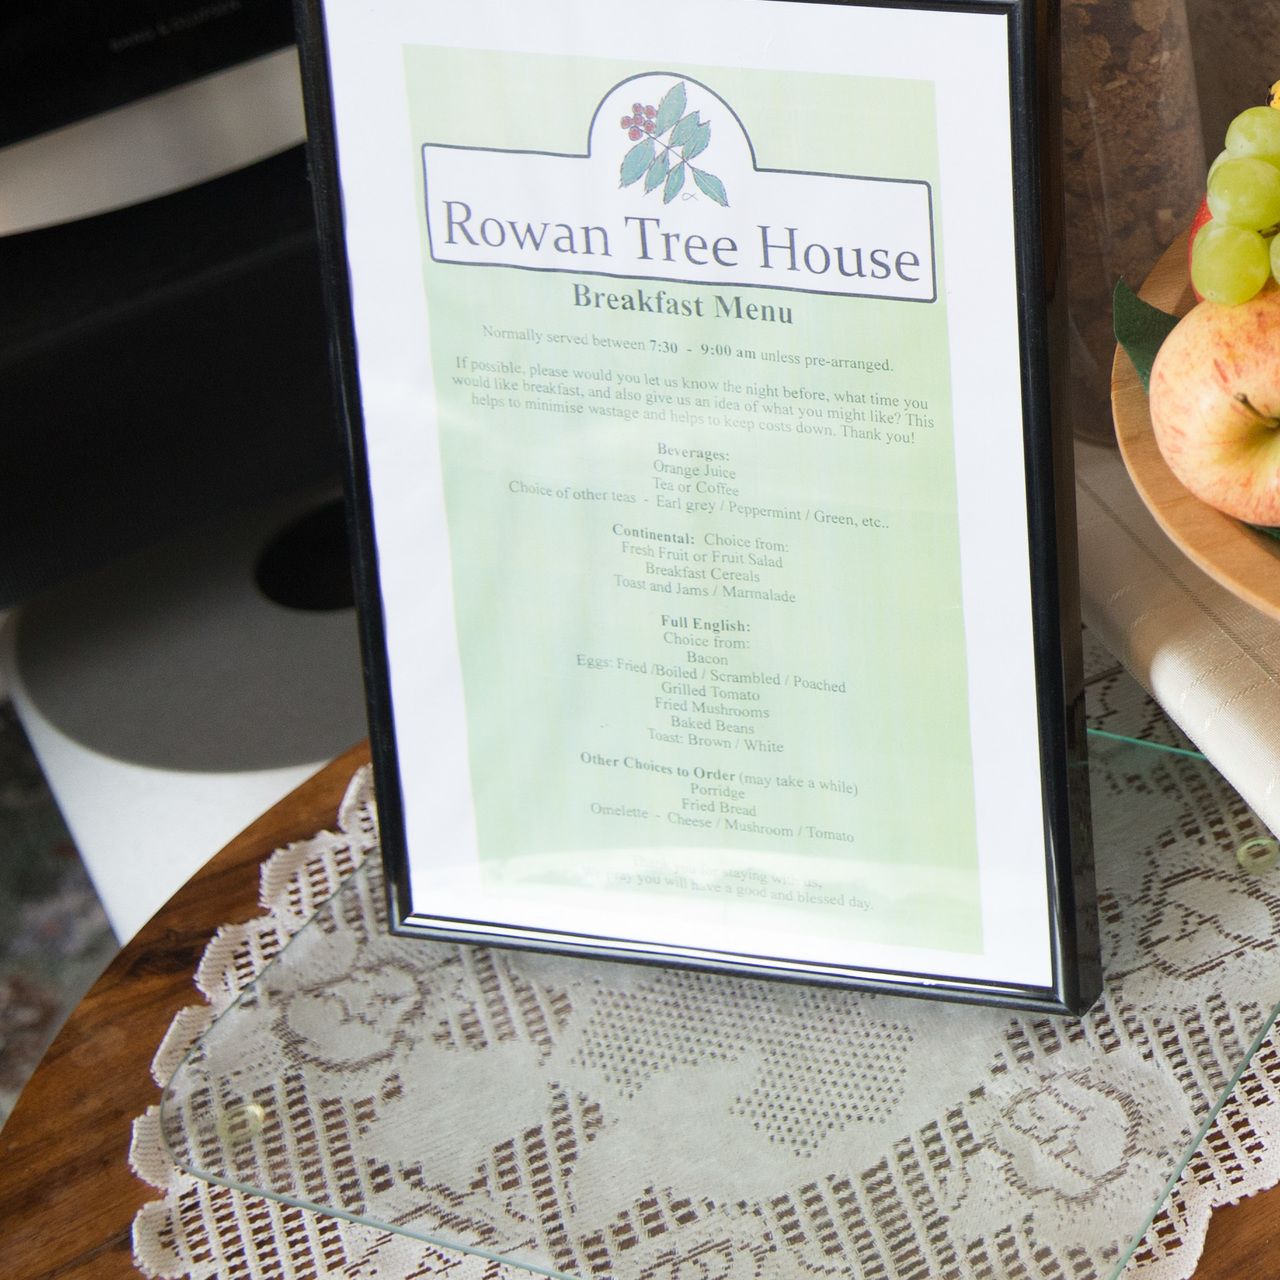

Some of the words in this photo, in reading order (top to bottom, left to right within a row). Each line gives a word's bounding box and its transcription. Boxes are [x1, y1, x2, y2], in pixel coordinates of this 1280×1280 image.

[442, 200, 612, 257] Rowan
[624, 216, 739, 267] Tree
[757, 225, 920, 282] House
[572, 282, 705, 317] Breakfast
[714, 295, 793, 324] Menu
[482, 324, 542, 344] Normally
[546, 330, 587, 344] served
[592, 334, 645, 350] between
[649, 339, 677, 352] 7:30
[700, 343, 731, 357] 9:00
[736, 349, 756, 359] am
[760, 348, 800, 363] unless
[804, 352, 893, 374] pre-arranged.
[456, 355, 469, 369] If
[529, 363, 568, 381] please
[572, 367, 612, 381] would
[616, 374, 640, 387] you
[644, 373, 660, 386] let
[664, 378, 677, 387] us
[681, 376, 718, 390] know
[723, 380, 741, 392] the
[746, 382, 778, 399] night
[782, 385, 829, 403] before,
[833, 389, 866, 403] what
[870, 393, 899, 406] time
[903, 398, 927, 412] you
[452, 373, 490, 388] would
[494, 377, 518, 390] like
[522, 380, 584, 399] breakfast,
[588, 386, 610, 399] and
[615, 388, 641, 401] also
[645, 394, 672, 407] give
[676, 396, 690, 406] us
[694, 398, 709, 407] an
[714, 397, 739, 410] idea
[744, 400, 758, 412] of
[762, 401, 793, 415] what
[798, 407, 822, 420] you
[827, 407, 865, 424] might
[870, 411, 901, 424] like?
[904, 414, 934, 428] This
[472, 393, 504, 410] helps
[508, 396, 520, 408] to
[525, 401, 583, 414] minimise
[588, 403, 639, 422] wastage
[643, 408, 665, 421] and
[670, 410, 703, 427] helps
[708, 414, 720, 426] to
[724, 415, 754, 432] keep
[758, 418, 791, 432] costs
[795, 422, 835, 436] down.
[840, 425, 881, 440] Thank
[885, 429, 914, 446] you!
[657, 443, 728, 463] Beverages:
[653, 461, 700, 479] Orange
[703, 465, 735, 478] Juice
[653, 476, 674, 490] Tea
[678, 483, 691, 492] or
[695, 481, 738, 495] Coffee
[508, 481, 552, 496] Choice
[556, 486, 570, 498] of
[572, 487, 607, 502] other
[611, 491, 635, 504] teas
[656, 495, 680, 508] Earl
[686, 501, 715, 515] grey
[728, 502, 800, 523] Peppermint
[813, 510, 858, 528] Green,
[612, 523, 694, 543] Continental:
[704, 533, 750, 549] Choice
[755, 538, 788, 552] from:
[622, 542, 654, 556] Fresh
[658, 545, 688, 559] Fruit
[692, 551, 707, 561] or
[711, 550, 744, 564] Fruit
[748, 554, 782, 568] Salad
[646, 562, 706, 578] Breakfast
[710, 568, 759, 582] Cereals
[614, 576, 646, 590] Toast
[649, 579, 671, 592] and
[676, 581, 708, 595] Jams
[722, 585, 795, 602] Marmalade
[661, 615, 687, 628] Full
[692, 617, 750, 634] English:
[663, 632, 708, 646] Choice
[713, 636, 749, 649] from:
[687, 652, 727, 666] Bacon
[617, 659, 646, 673] Fried
[710, 668, 780, 686] Scrambled
[793, 677, 846, 693] Poached
[661, 682, 706, 696] Grilled
[710, 686, 759, 700] Tomato
[655, 697, 687, 711] Fried
[692, 701, 769, 718] Mushrooms
[671, 716, 711, 731] Baked
[716, 720, 754, 734] Beans
[649, 728, 683, 743] Toast:
[688, 732, 731, 747] Brown
[744, 738, 783, 752] White
[580, 752, 619, 767] Other
[623, 757, 672, 773] Choices
[676, 765, 689, 777] to
[693, 765, 735, 780] Order
[738, 770, 770, 788] (may
[776, 774, 803, 788] take
[819, 779, 857, 797] while)
[690, 783, 744, 802] Porridge
[681, 798, 715, 813] Fried
[719, 802, 756, 816] Bread
[590, 802, 648, 820] Omelette
[667, 811, 712, 827] Cheese
[724, 817, 792, 835] Mushroom
[805, 826, 854, 842] Tomato
[637, 874, 661, 886] you
[664, 874, 687, 888] will
[737, 885, 766, 898] good
[771, 889, 793, 901] and
[797, 890, 845, 907] blessed
[849, 895, 873, 911] day.
